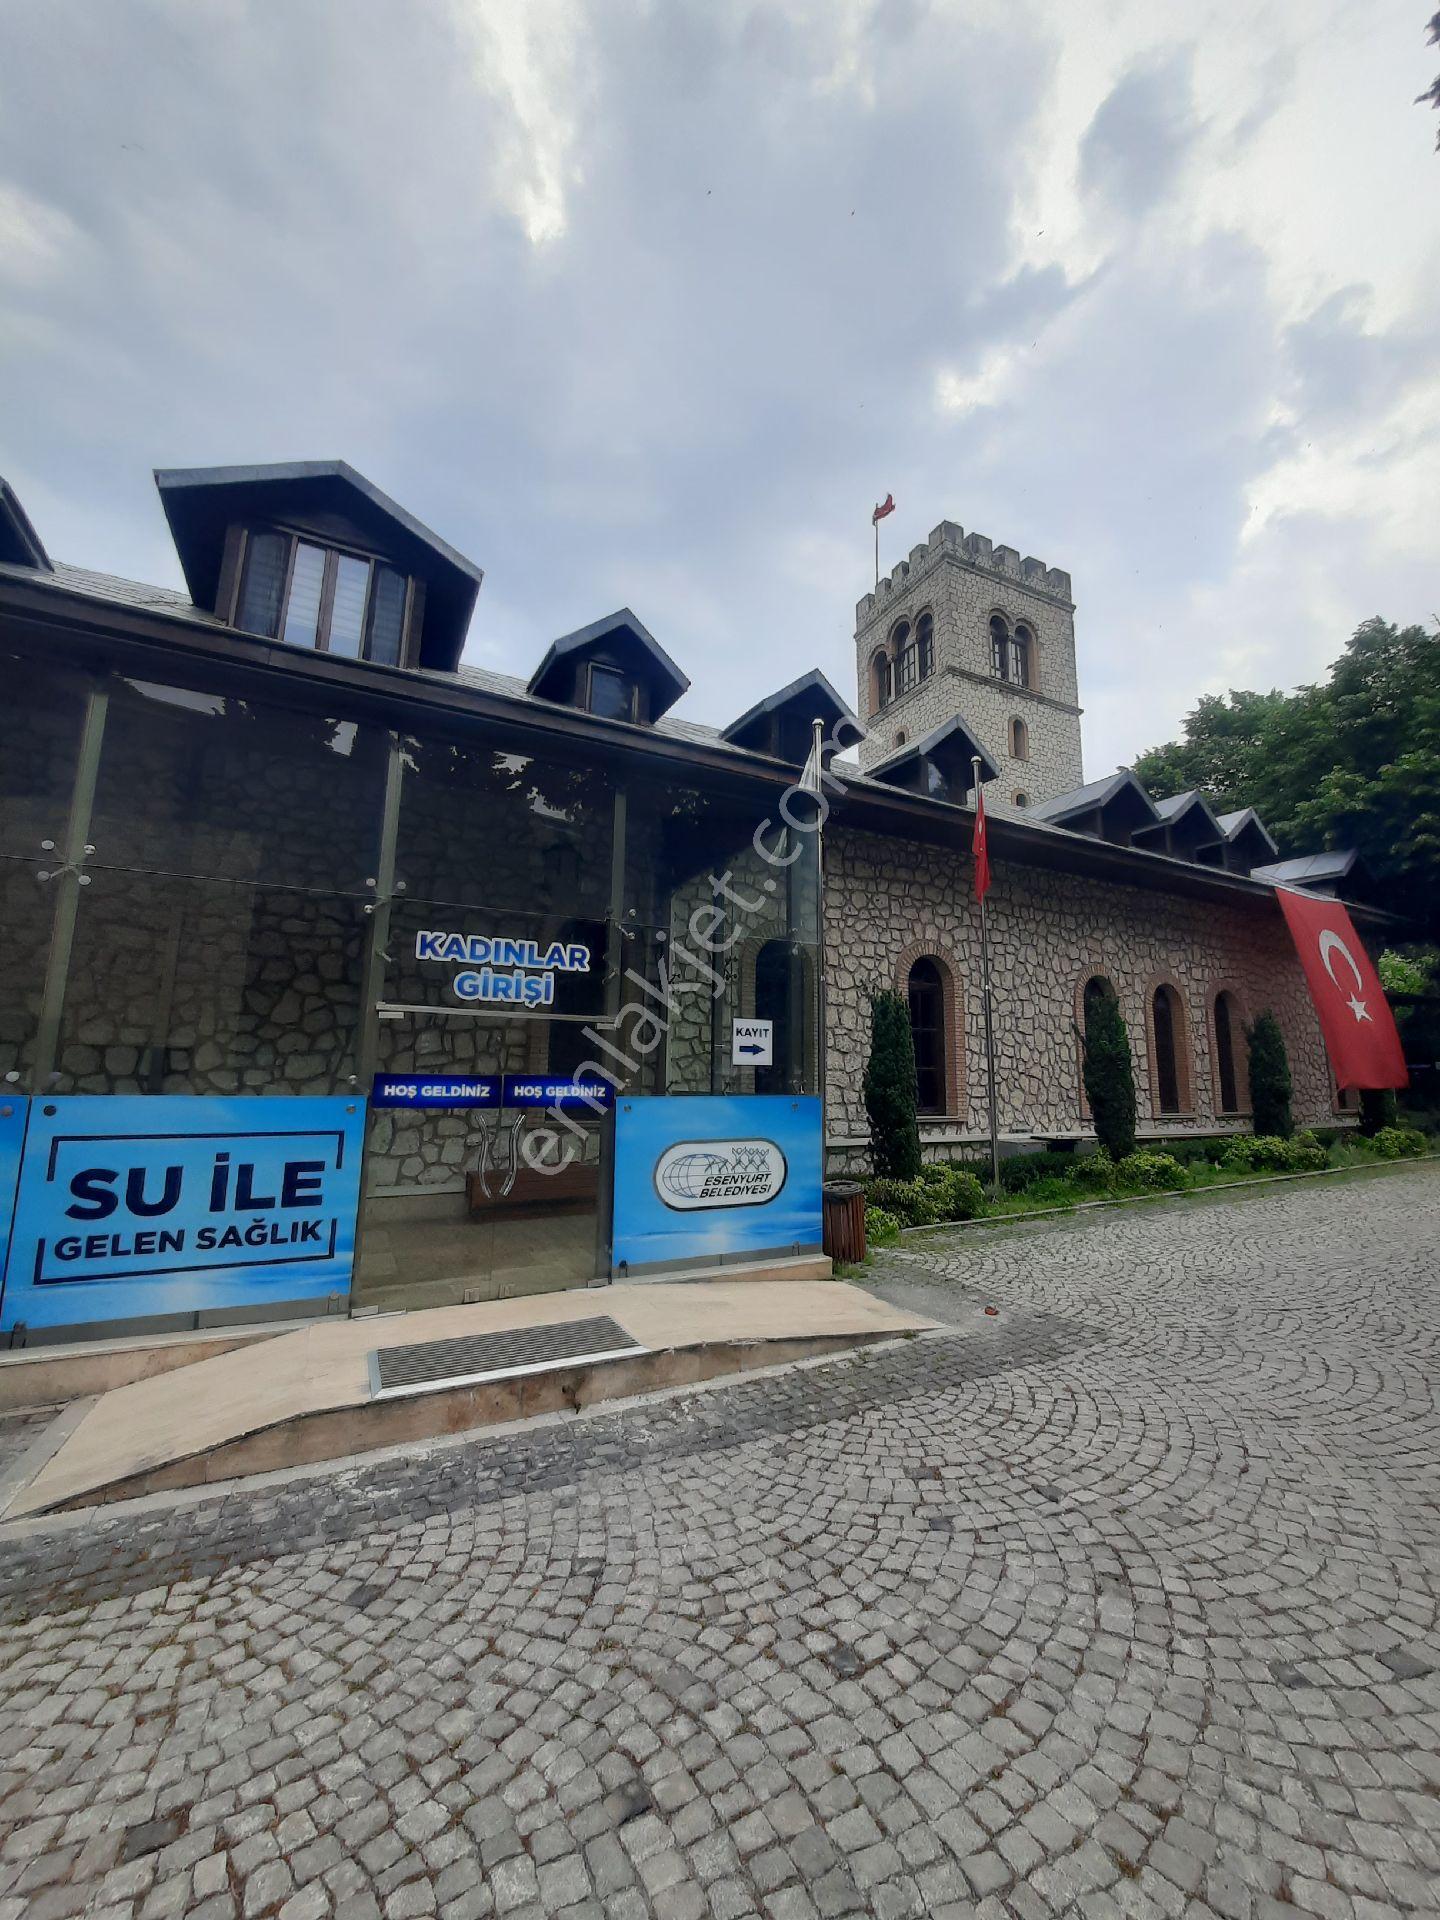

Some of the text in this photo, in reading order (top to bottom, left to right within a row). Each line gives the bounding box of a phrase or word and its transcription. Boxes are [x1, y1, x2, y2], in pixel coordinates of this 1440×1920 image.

[416, 931, 590, 972] KADINLAR
[453, 967, 555, 1008] GİRİŞİ
[736, 1027, 769, 1038] KAYIT
[384, 1083, 490, 1099] HOŞ GELDİNİZ
[514, 1084, 606, 1099] HOŞ GELDİNİZ
[65, 1152, 326, 1220] SU İLE
[704, 1173, 772, 1186] ESENYURT
[54, 1218, 324, 1261] GELEN SAĞLIK
